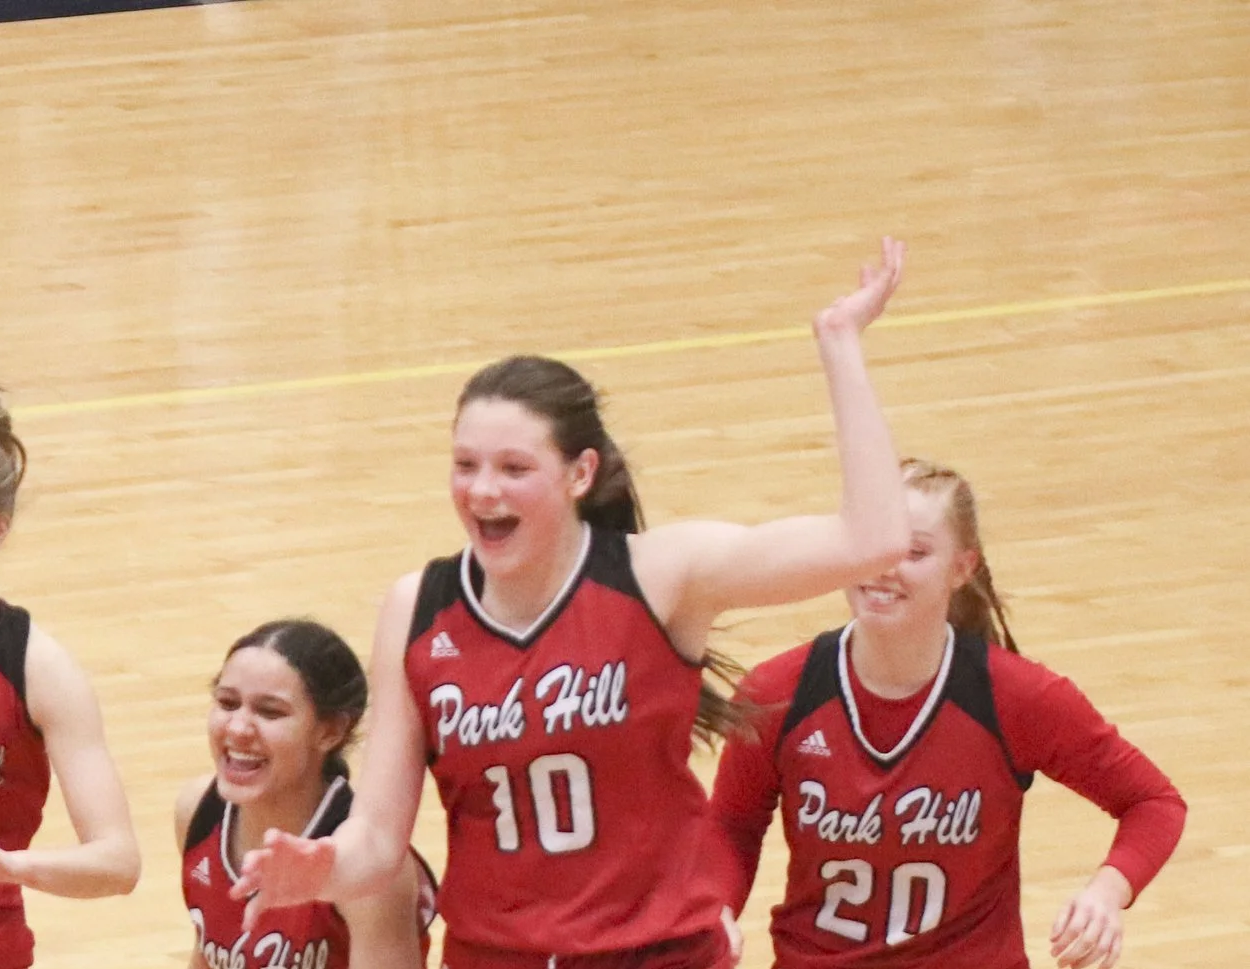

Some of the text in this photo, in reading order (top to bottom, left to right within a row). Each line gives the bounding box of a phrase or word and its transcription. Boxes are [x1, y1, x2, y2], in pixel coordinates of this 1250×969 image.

[429, 660, 630, 755] Park Hill
[483, 752, 596, 854] 10
[798, 779, 982, 845] Park Hill
[814, 857, 947, 945] 20
